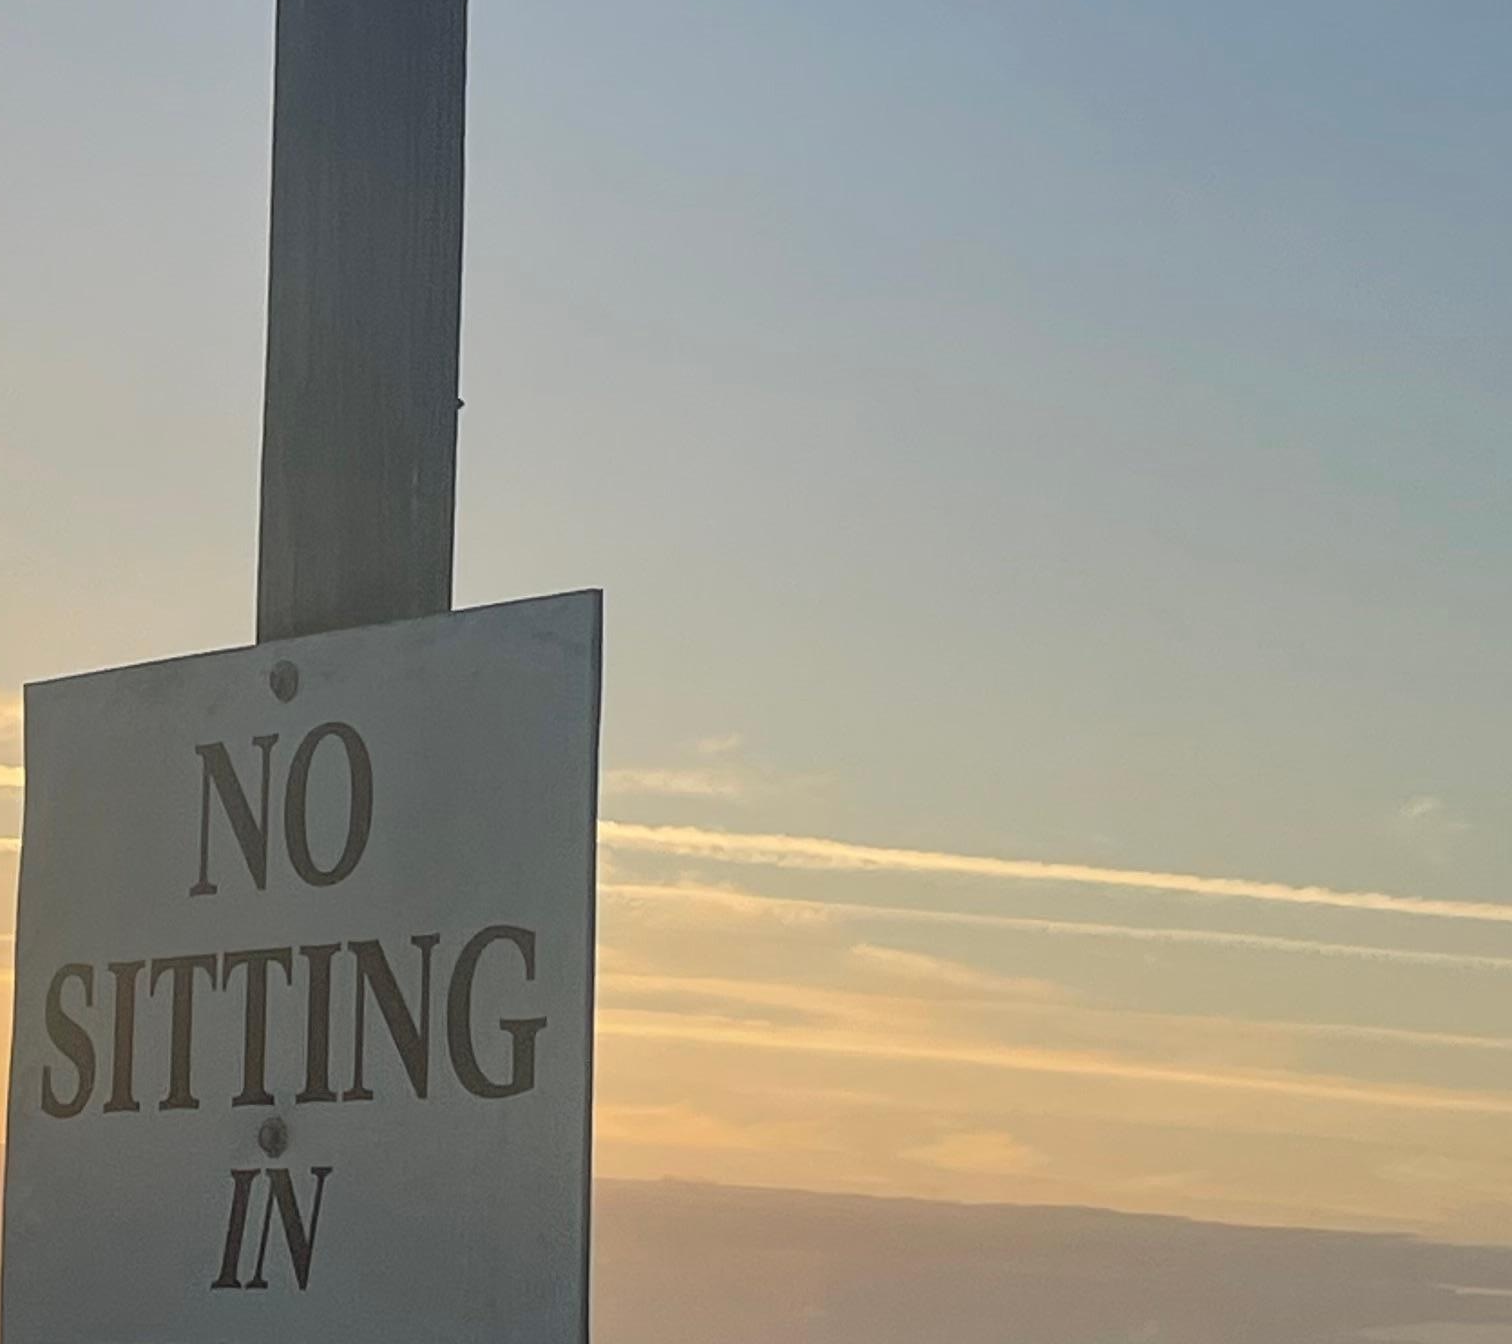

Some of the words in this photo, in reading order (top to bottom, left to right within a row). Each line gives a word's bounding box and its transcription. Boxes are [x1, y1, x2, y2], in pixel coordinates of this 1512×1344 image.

[189, 721, 373, 896] NO
[41, 924, 547, 1118] SITTING
[210, 1167, 333, 1290] IN
